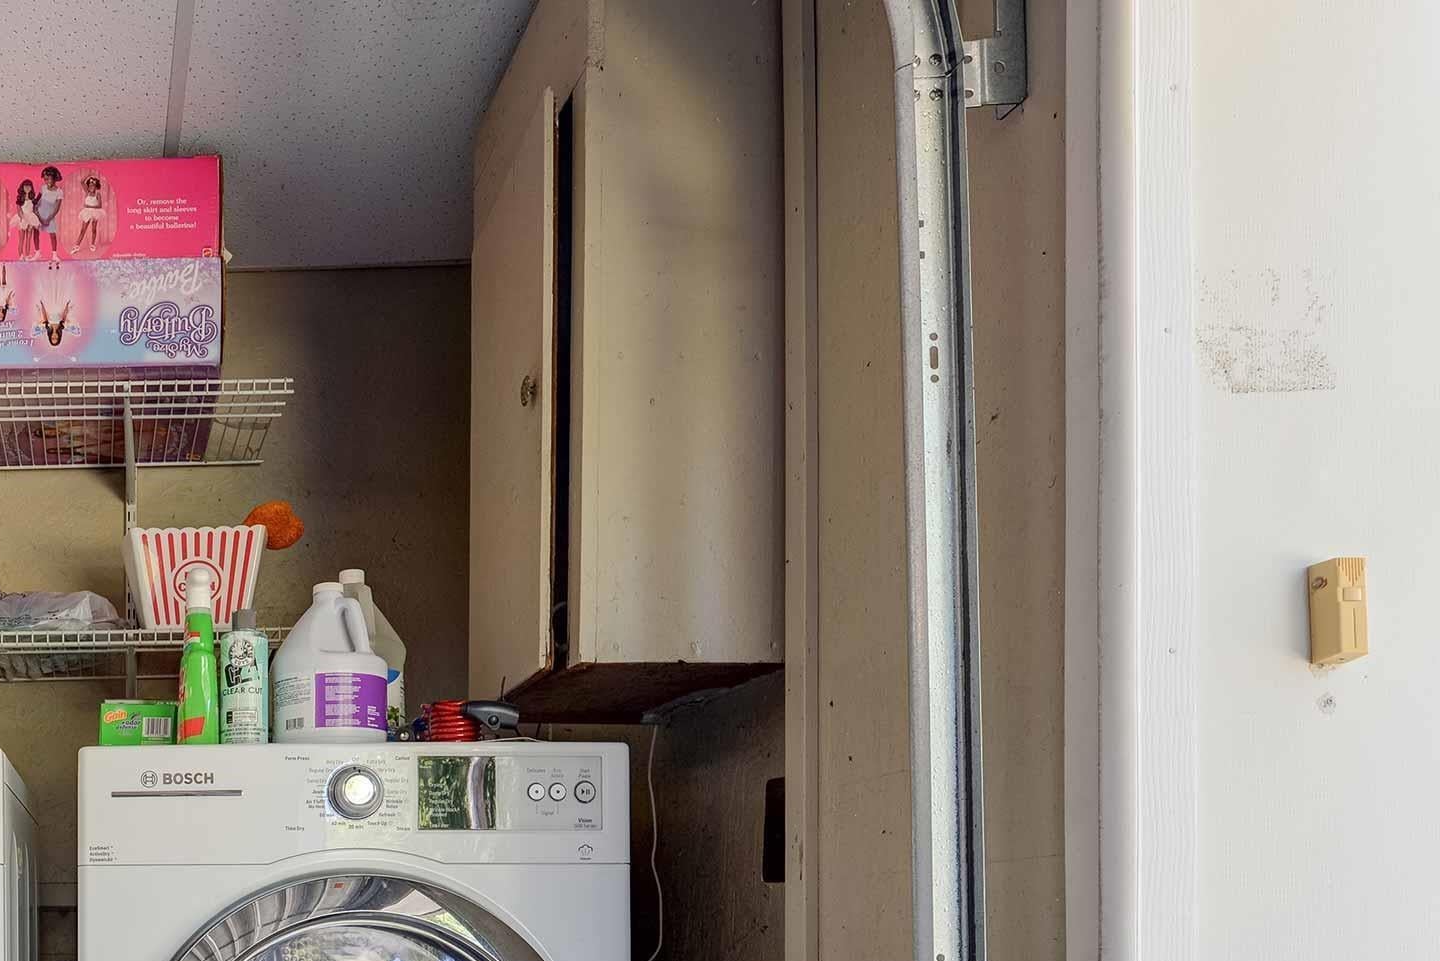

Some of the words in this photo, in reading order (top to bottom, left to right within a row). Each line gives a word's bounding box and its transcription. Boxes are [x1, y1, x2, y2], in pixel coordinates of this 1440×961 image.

[175, 197, 187, 205] the
[136, 222, 165, 230] beautiful
[129, 262, 202, 303] Barbie
[119, 301, 218, 346] Butterfly
[146, 340, 178, 359] Size
[179, 337, 208, 359] My
[223, 687, 246, 696] CLEAR
[248, 686, 263, 695] CUT
[104, 709, 128, 723] Gain
[162, 772, 214, 785] BOSCH
